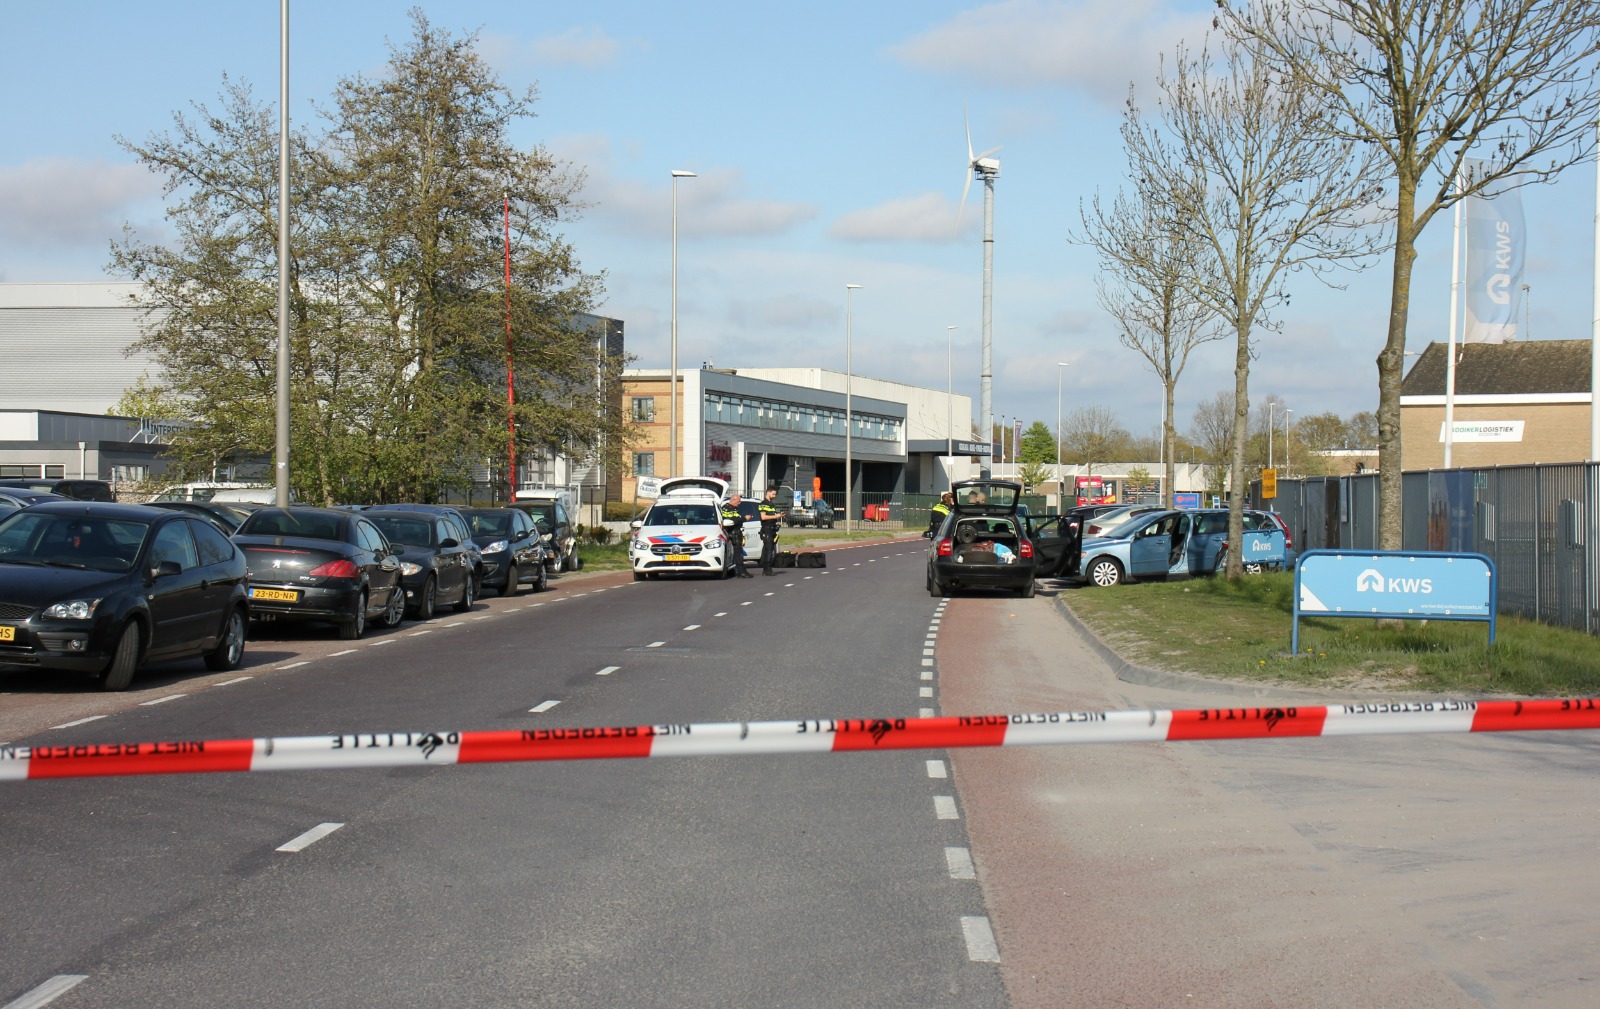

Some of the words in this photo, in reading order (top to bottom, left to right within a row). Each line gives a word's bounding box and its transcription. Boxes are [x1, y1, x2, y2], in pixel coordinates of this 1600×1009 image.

[1496, 220, 1511, 269] KWS
[1260, 542, 1271, 551] KWS
[1388, 578, 1433, 594] KWS
